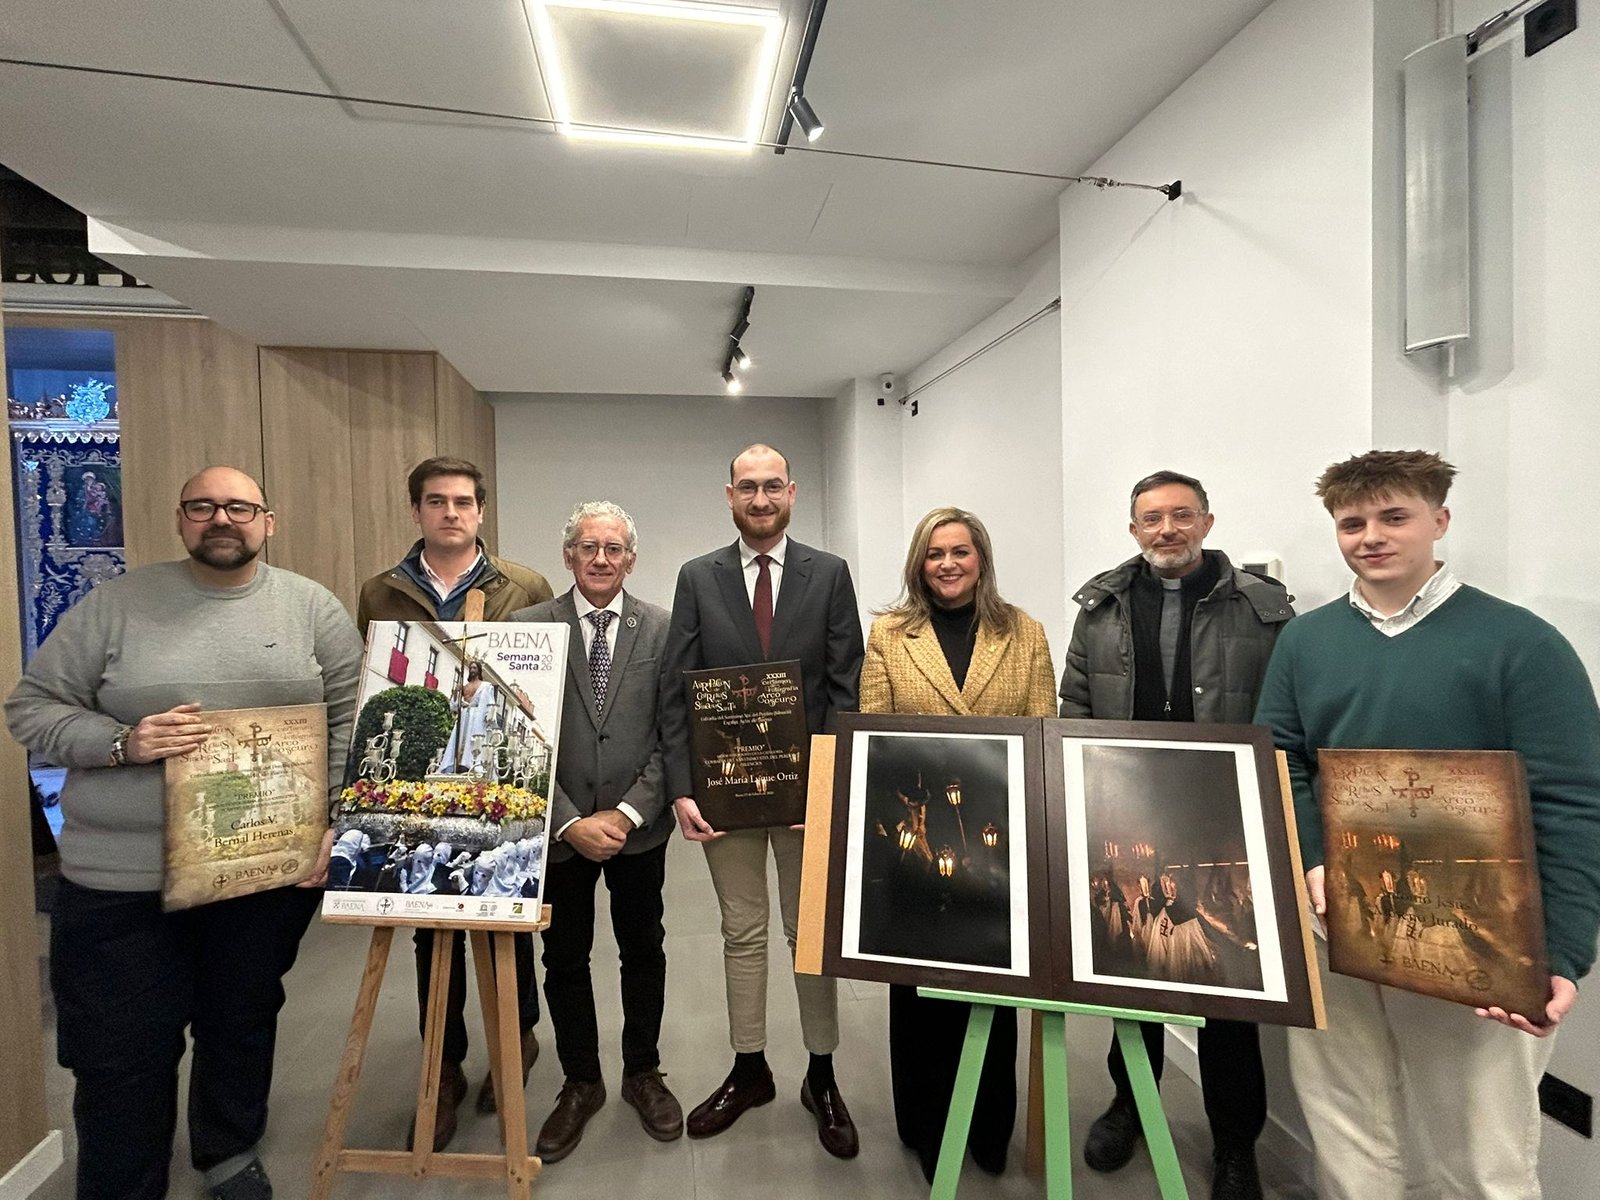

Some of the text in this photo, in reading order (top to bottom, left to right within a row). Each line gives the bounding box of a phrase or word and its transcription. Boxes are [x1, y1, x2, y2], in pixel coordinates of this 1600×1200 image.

[488, 632, 552, 652] BAENA
[497, 652, 553, 662] Semana 20
[508, 662, 539, 670] Santa
[707, 778, 723, 788] José
[725, 776, 748, 784] María
[776, 772, 799, 780] Ortiz
[230, 814, 278, 830] Carlos V.
[215, 833, 249, 847] Bernal
